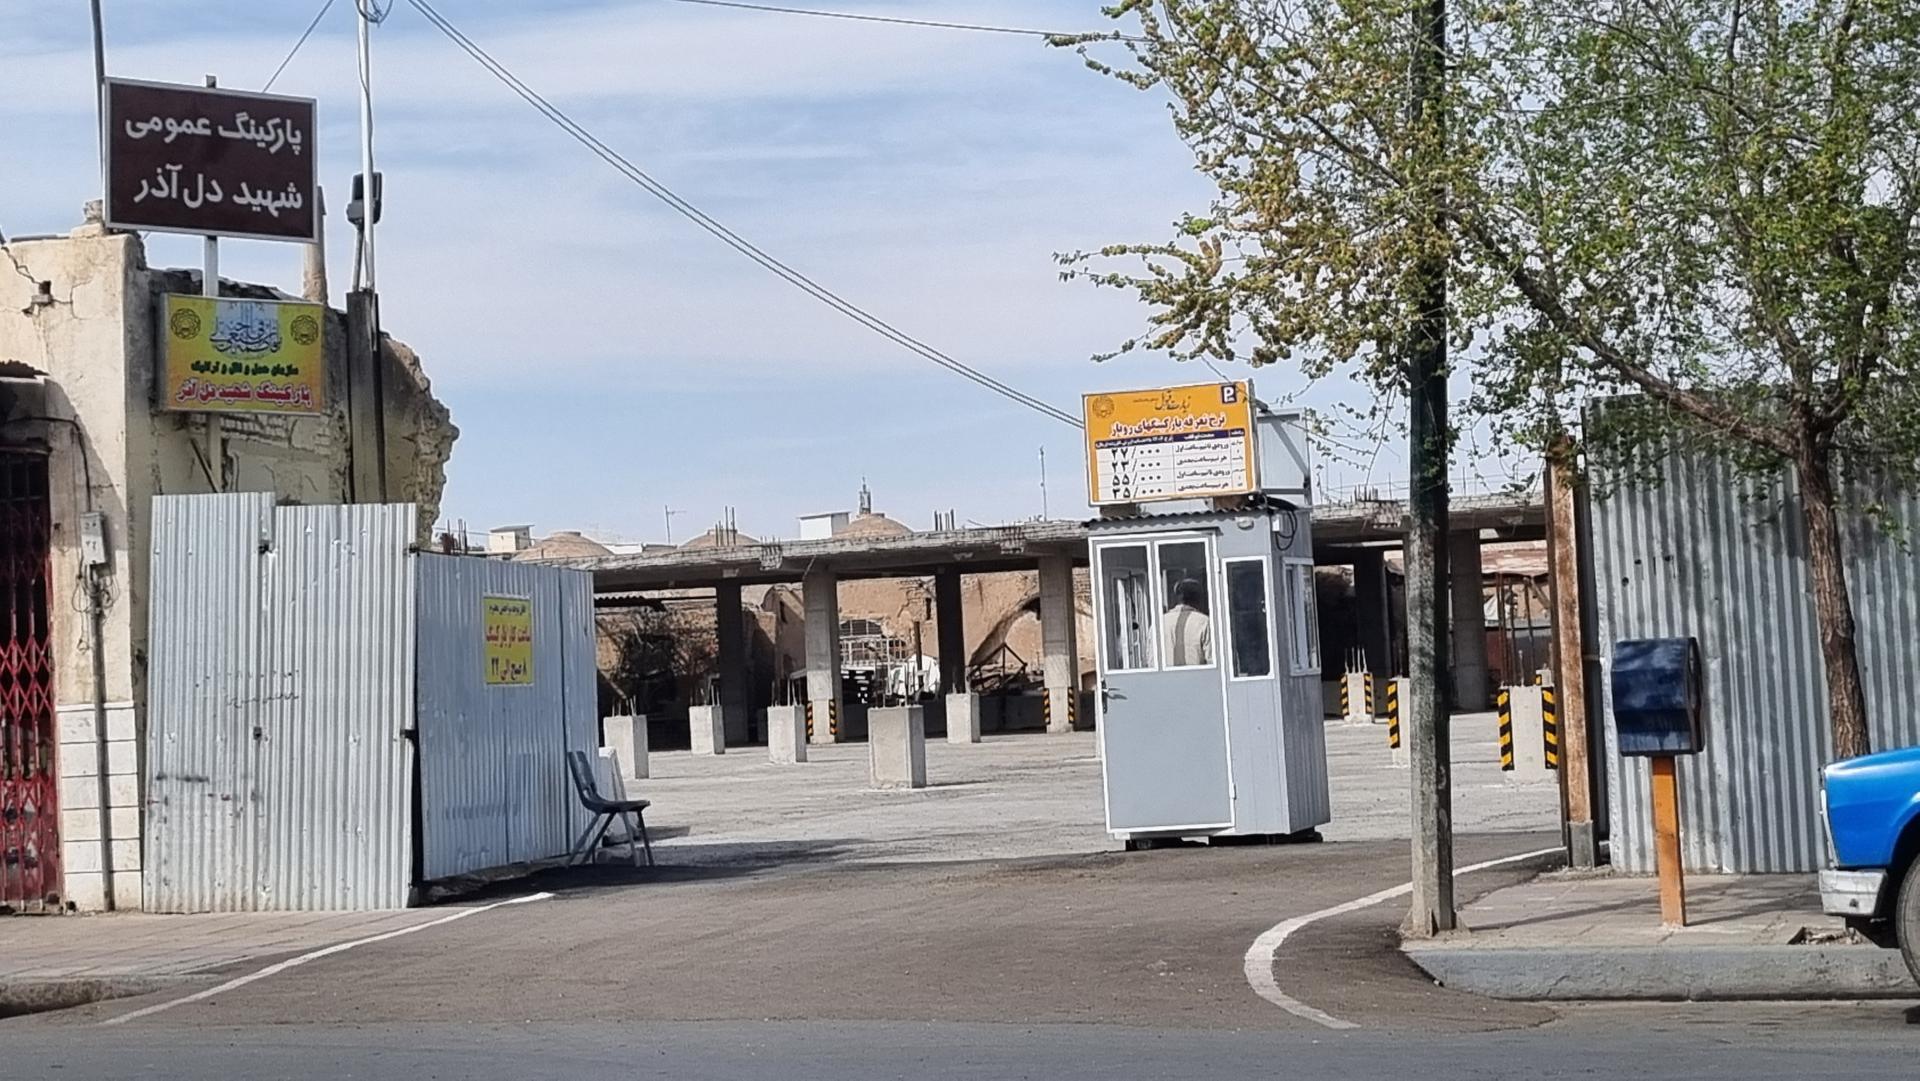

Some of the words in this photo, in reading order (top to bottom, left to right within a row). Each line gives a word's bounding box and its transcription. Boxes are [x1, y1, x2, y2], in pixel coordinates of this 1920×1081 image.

[125, 115, 211, 144] عمومی
[218, 112, 301, 156] پارکینگ
[133, 163, 184, 204] آذر
[183, 173, 224, 209] دل
[233, 182, 302, 218] شهید
[1223, 386, 1235, 403] P
[1208, 414, 1226, 429] نرخ
[1111, 445, 1160, 459] ۲۷/۰۰۰
[1111, 458, 1161, 472] ۲۳/۰۰۰
[1112, 472, 1161, 486] ۵۵/۰۰۰
[1112, 484, 1162, 499] ۳۵/۰۰۰
